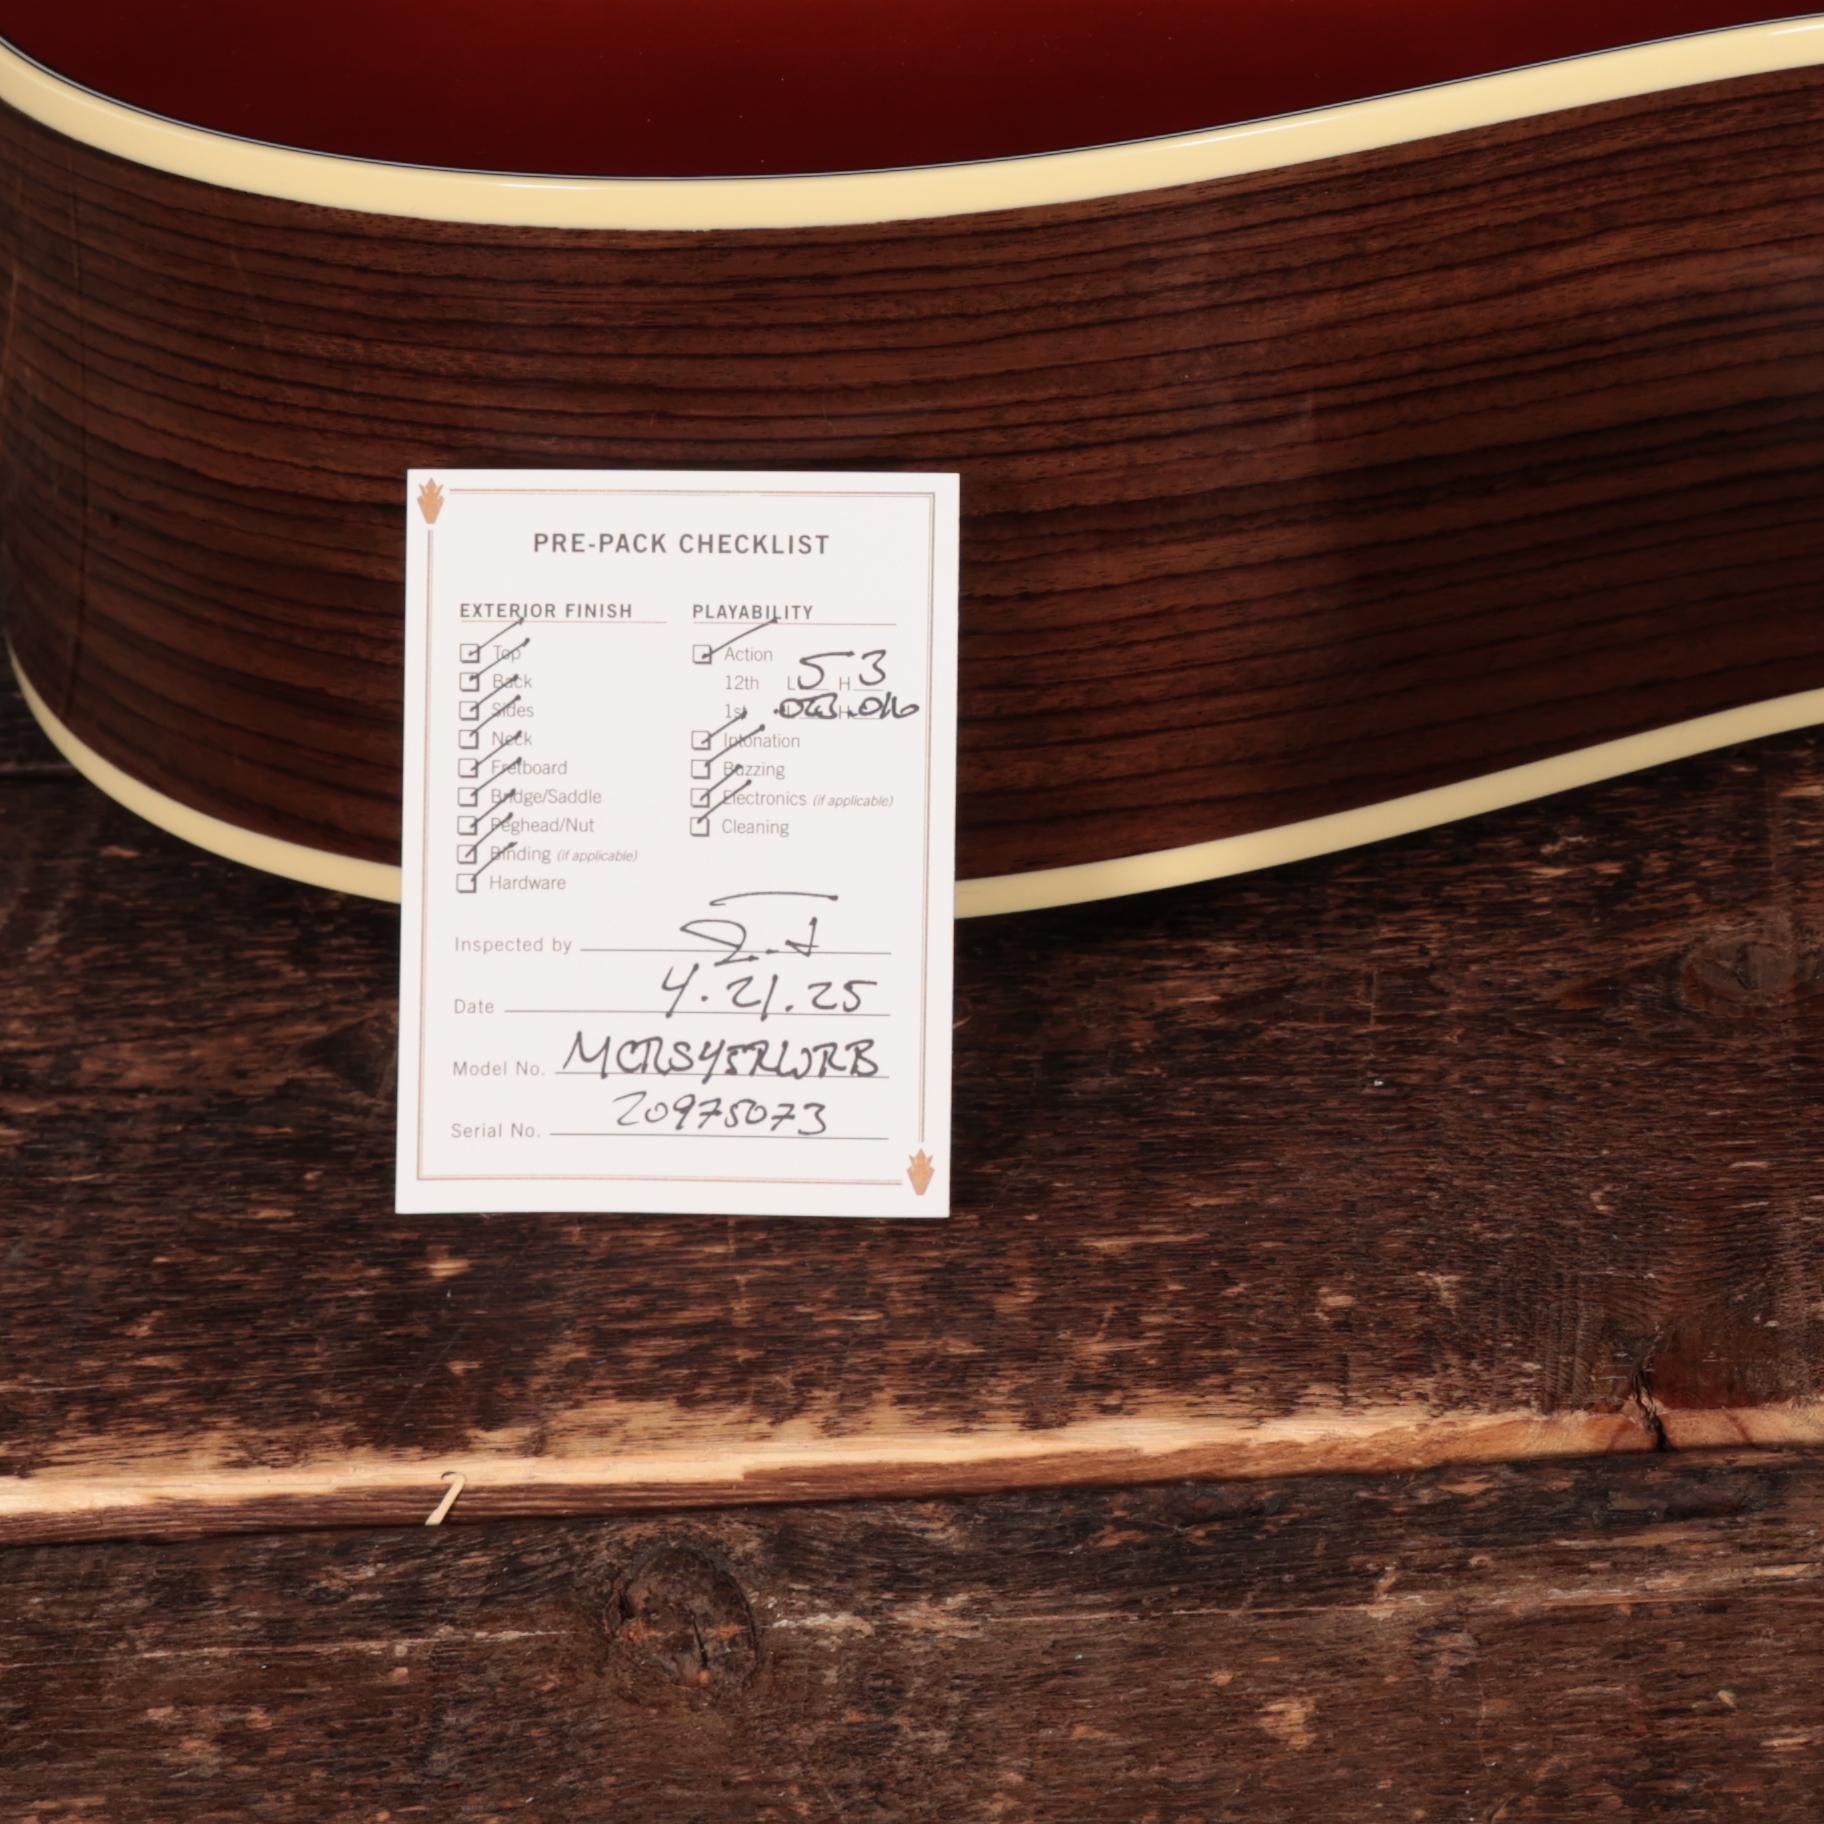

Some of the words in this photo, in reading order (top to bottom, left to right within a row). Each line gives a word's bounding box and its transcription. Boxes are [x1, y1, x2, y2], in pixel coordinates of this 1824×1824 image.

[533, 533, 667, 554] PRE-PACK
[678, 534, 831, 555] CHECKLIST
[460, 603, 556, 618] EXTERIOR
[566, 603, 632, 619] FINISH
[692, 604, 814, 620] PLAYABILITY
[493, 644, 521, 663] Top
[724, 646, 773, 662] Action
[859, 649, 886, 686] 3
[493, 673, 533, 689] Back
[725, 674, 759, 691] 12th
[839, 676, 851, 691] H
[491, 702, 535, 718] Sides
[725, 703, 747, 719] 1st
[491, 730, 533, 747] Neck
[723, 732, 800, 748] Intonation
[491, 759, 568, 775] Fretboard
[723, 760, 785, 780] Buzzing
[491, 788, 602, 807] Bridge/Saddle
[722, 789, 807, 806] Electronics
[812, 793, 826, 808] (if
[828, 793, 894, 808] applicable)
[490, 816, 595, 836] Peghead/Nut
[721, 818, 789, 837] Cleaning
[490, 846, 551, 864] Binding
[556, 849, 569, 863] (if
[571, 849, 639, 863] applicable)
[489, 875, 566, 890] Hardware
[454, 936, 544, 955] Inspected
[551, 936, 572, 955] by
[454, 998, 494, 1015] Date
[452, 1060, 507, 1078] Model
[516, 1060, 546, 1078] No.
[612, 1090, 827, 1136] 20975073
[451, 1123, 502, 1139] Serial
[511, 1123, 541, 1139] No.
